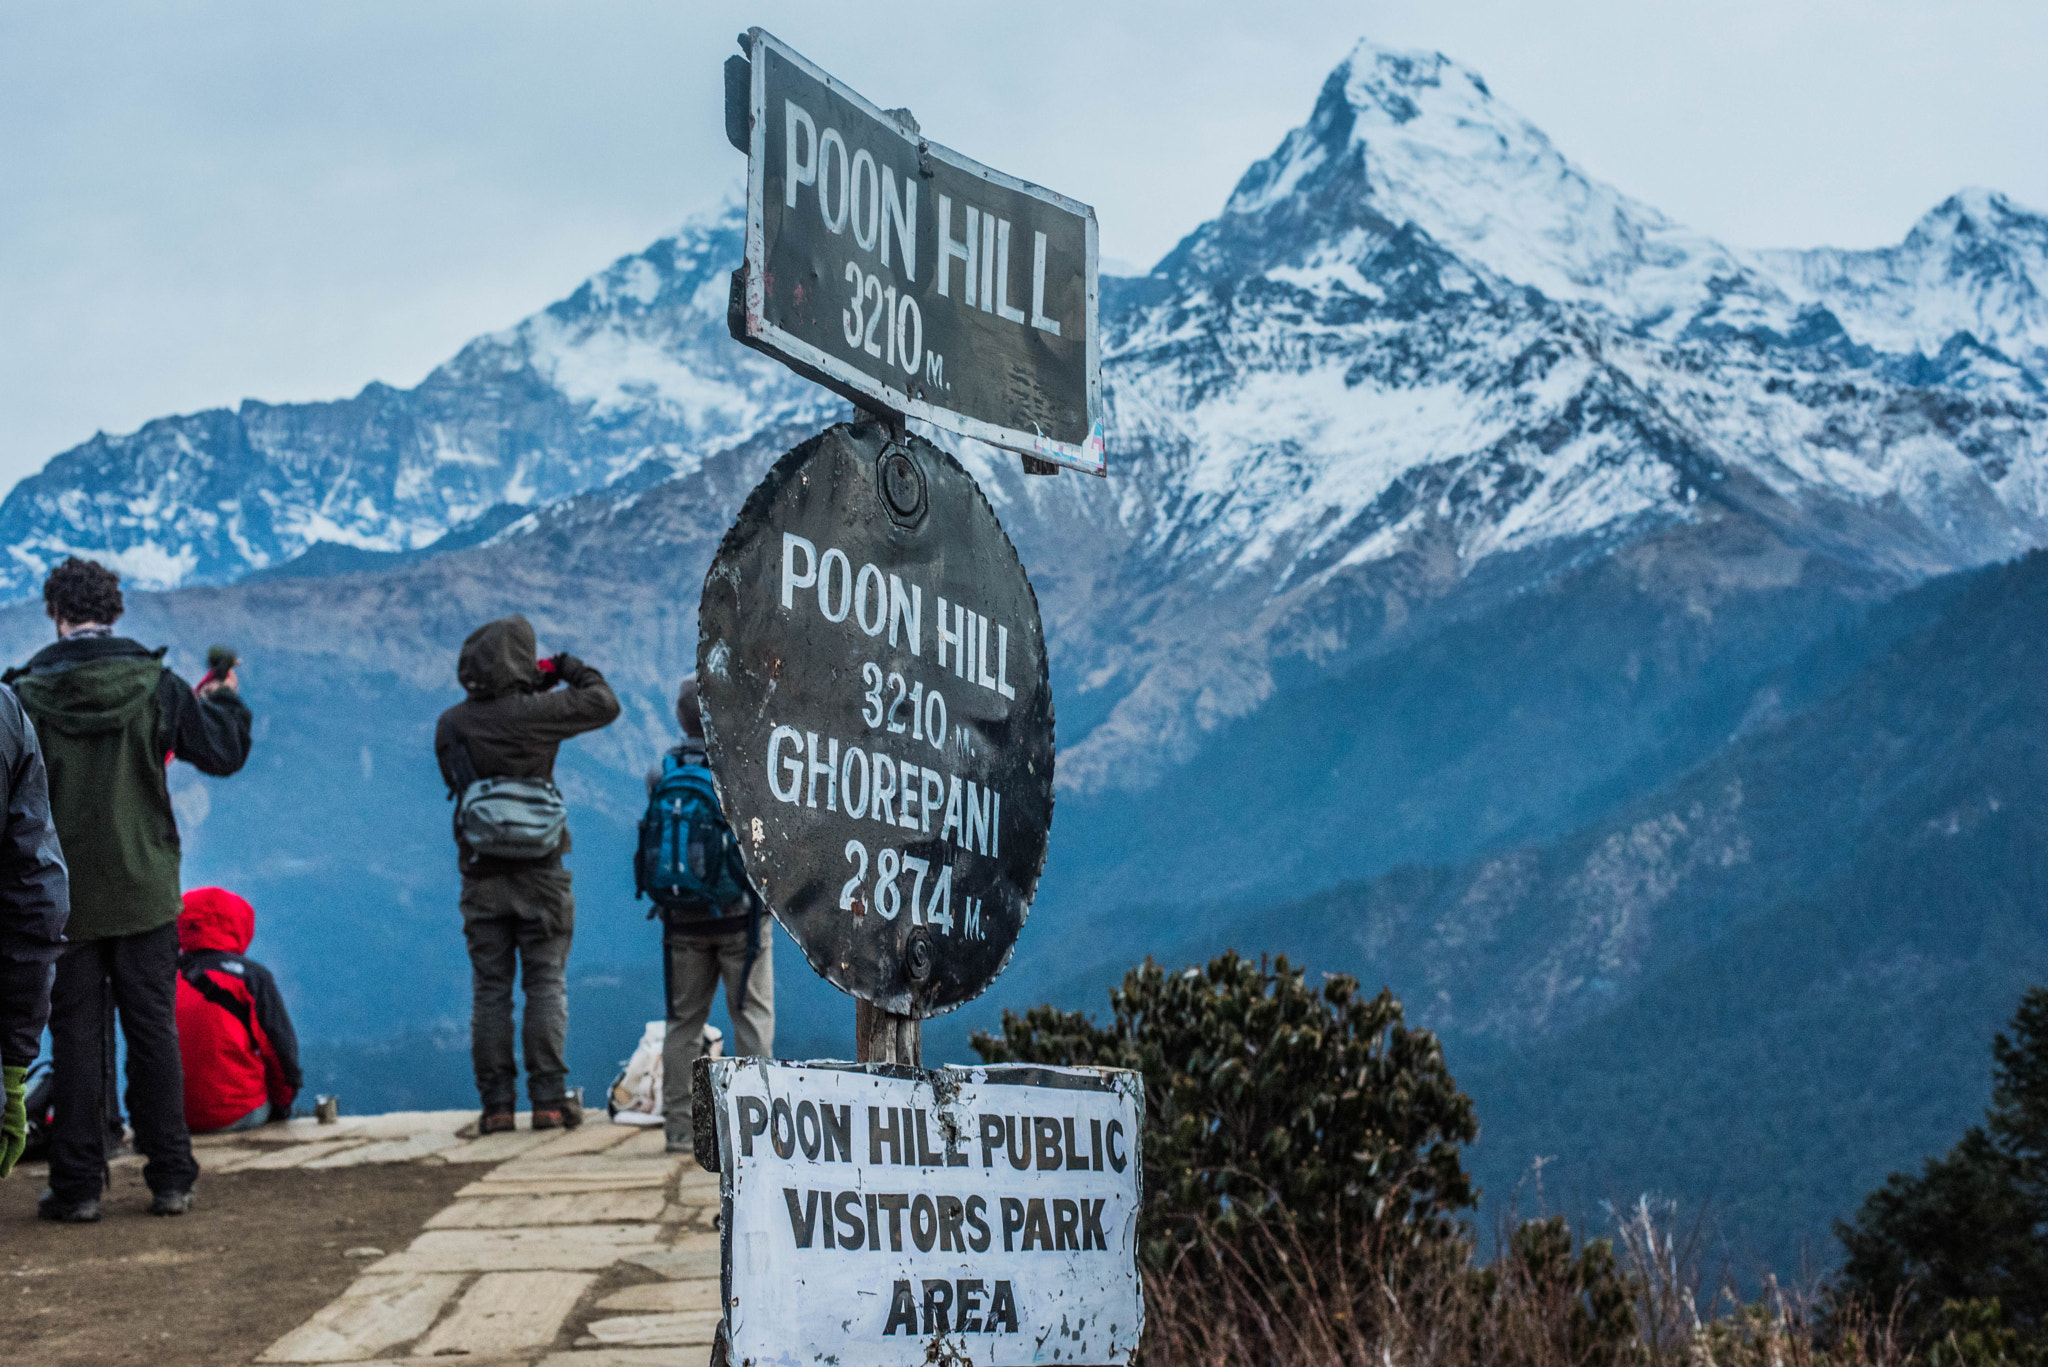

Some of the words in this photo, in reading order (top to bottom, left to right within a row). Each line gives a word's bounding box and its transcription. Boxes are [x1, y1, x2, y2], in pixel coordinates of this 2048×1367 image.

[785, 98, 917, 282] POON
[938, 193, 1061, 336] HILL
[842, 261, 922, 375] 3210
[781, 532, 921, 656] POON
[937, 596, 1015, 700] HILL
[862, 662, 946, 750] 3210
[767, 725, 1000, 859] GHOREPANI
[839, 839, 954, 937] 2874
[736, 1095, 851, 1163] POON
[869, 1106, 969, 1167] HILL
[979, 1113, 1127, 1174] PUBLIC
[783, 1188, 991, 1253] VISITORS
[1000, 1197, 1107, 1252] PARK
[883, 1279, 1018, 1336] AREA
